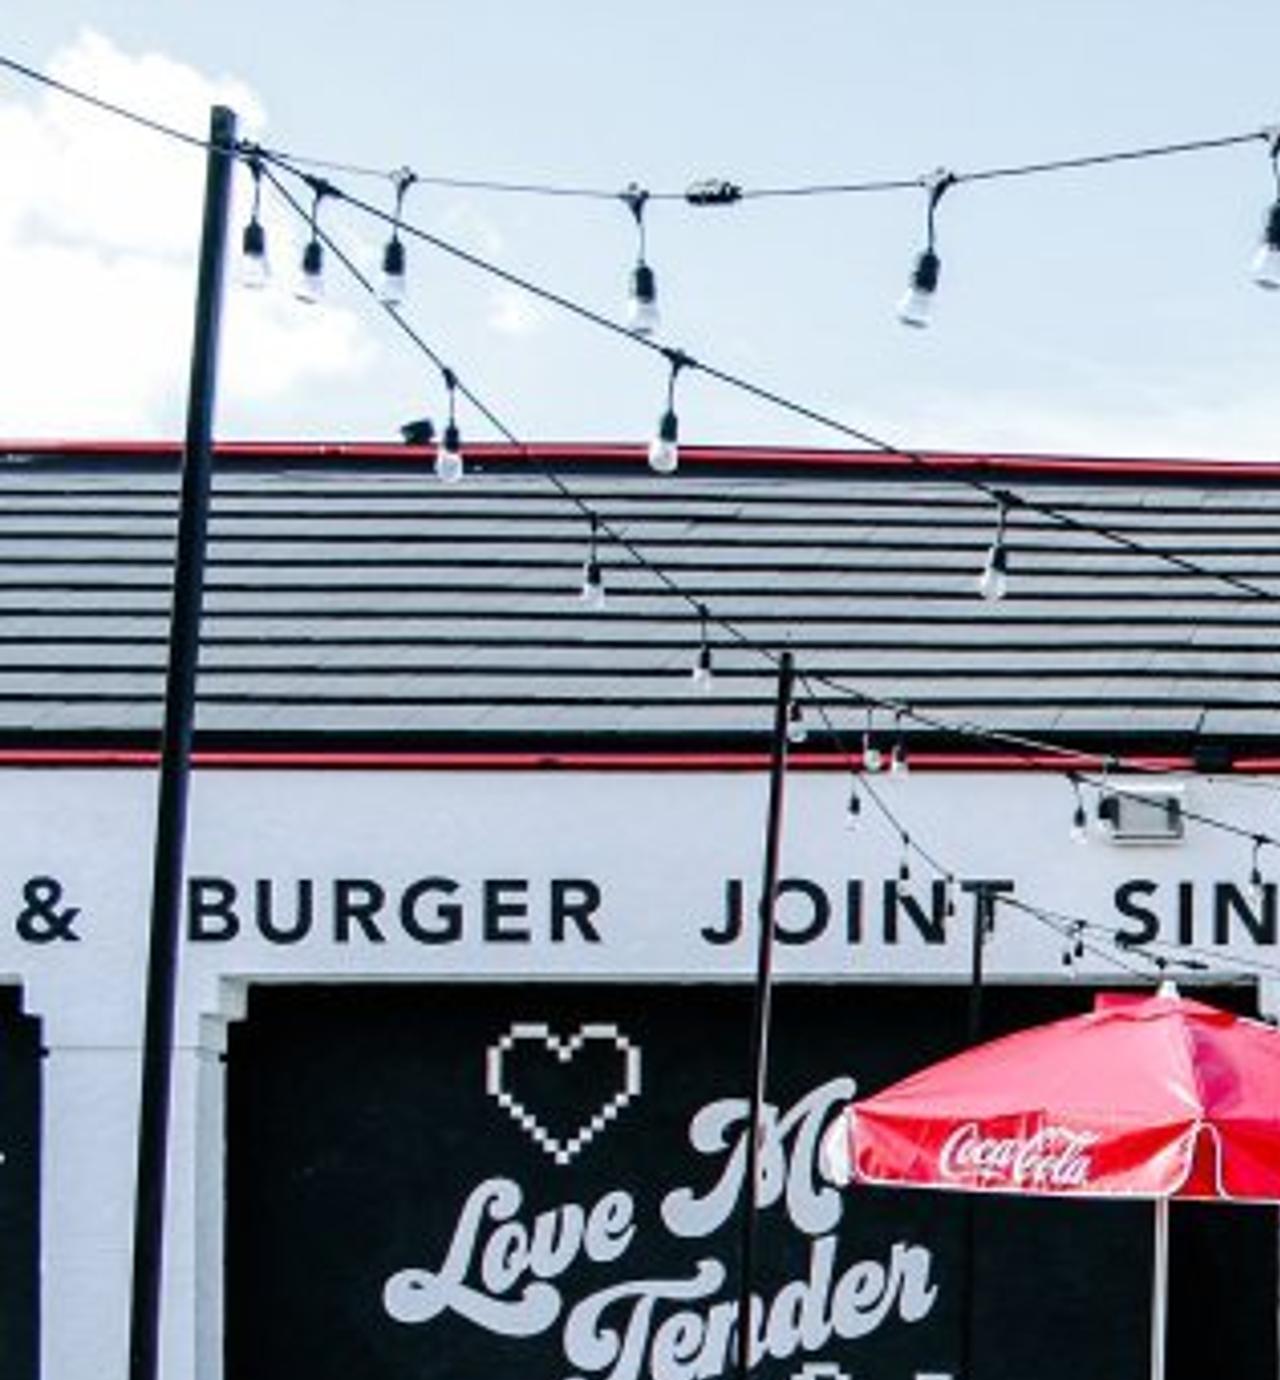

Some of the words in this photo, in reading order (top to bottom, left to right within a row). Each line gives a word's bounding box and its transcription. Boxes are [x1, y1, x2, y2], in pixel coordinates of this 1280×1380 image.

[15, 876, 82, 944] &
[186, 877, 604, 945] BURGER
[700, 879, 1015, 944] JOINT
[383, 1177, 637, 1338] Love
